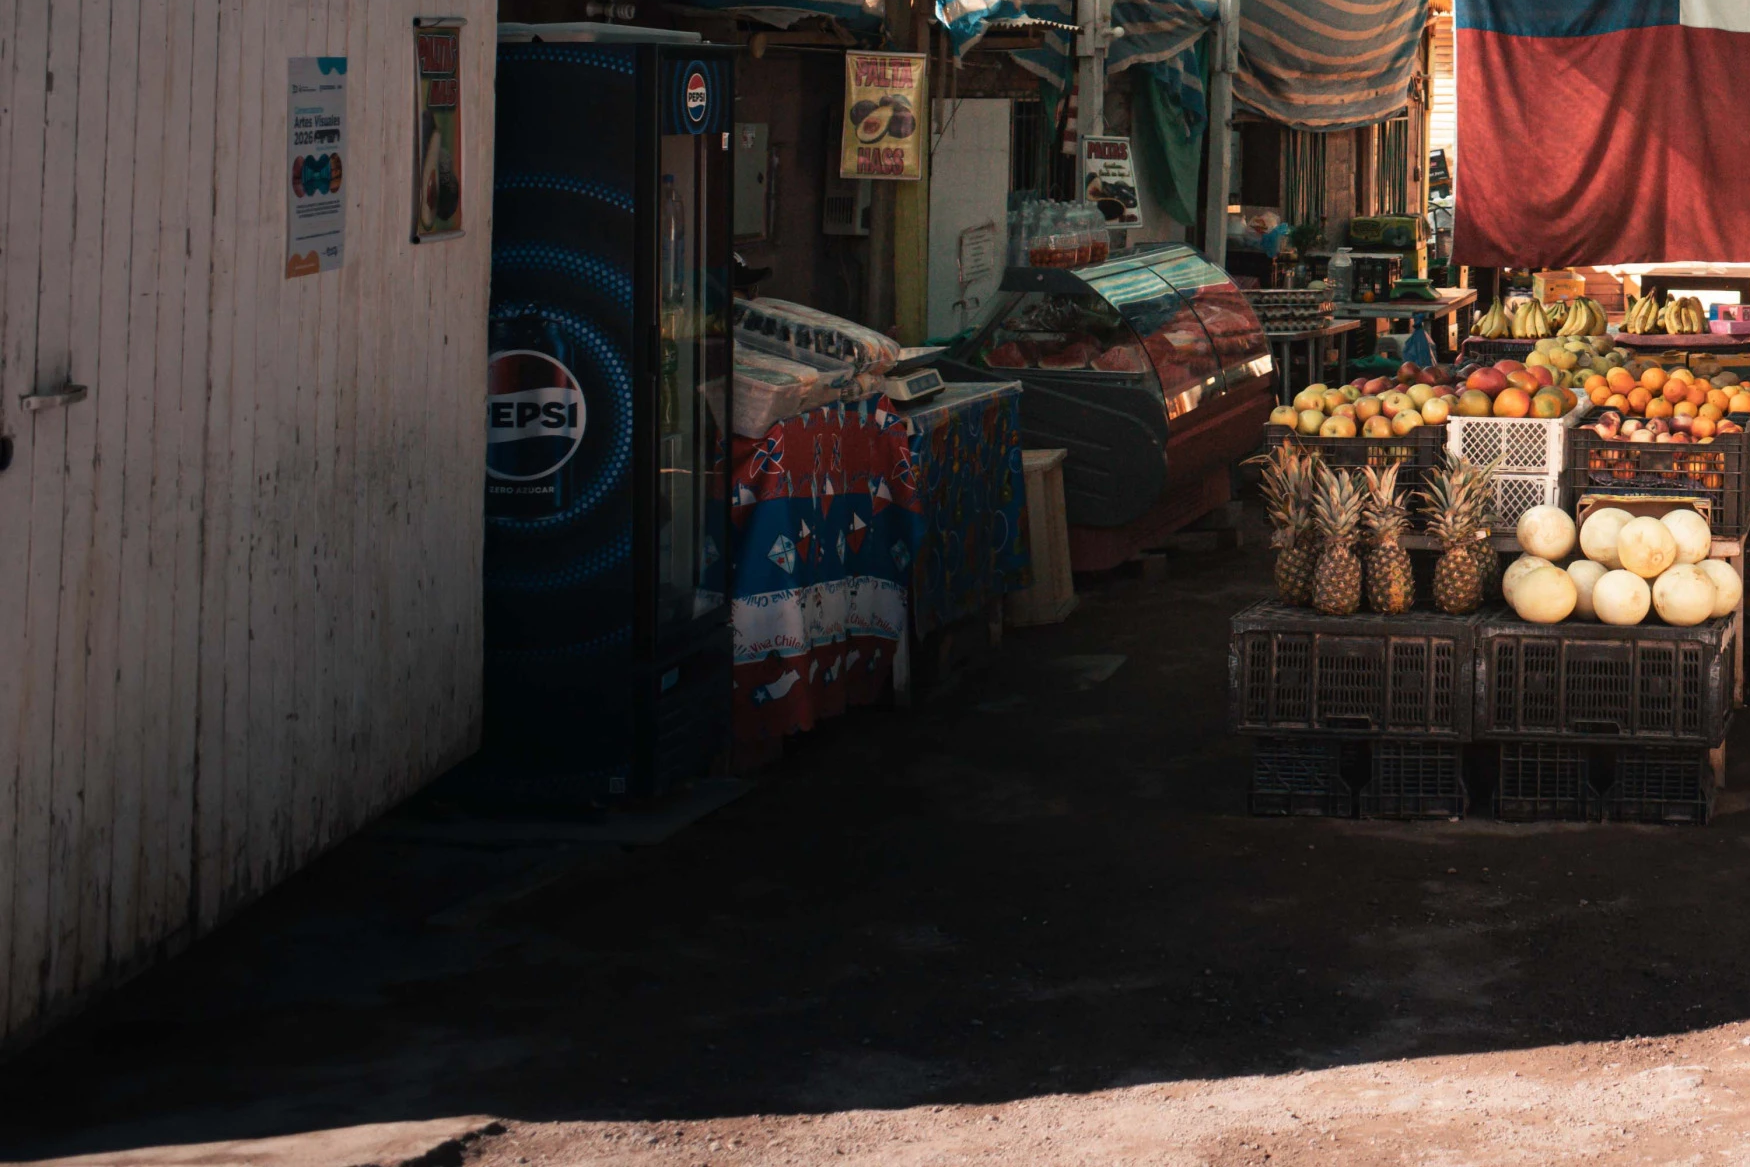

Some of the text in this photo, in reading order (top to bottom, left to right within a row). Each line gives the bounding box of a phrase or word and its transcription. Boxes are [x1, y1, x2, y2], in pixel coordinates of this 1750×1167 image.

[855, 57, 913, 88] PALTA
[689, 92, 706, 102] PEPSI
[294, 114, 340, 128] Artes Visuales
[1087, 141, 1128, 160] PALTAS
[857, 147, 904, 175] HASS
[488, 402, 577, 428] EPSI
[489, 485, 555, 494] ZERO AZUCAR
